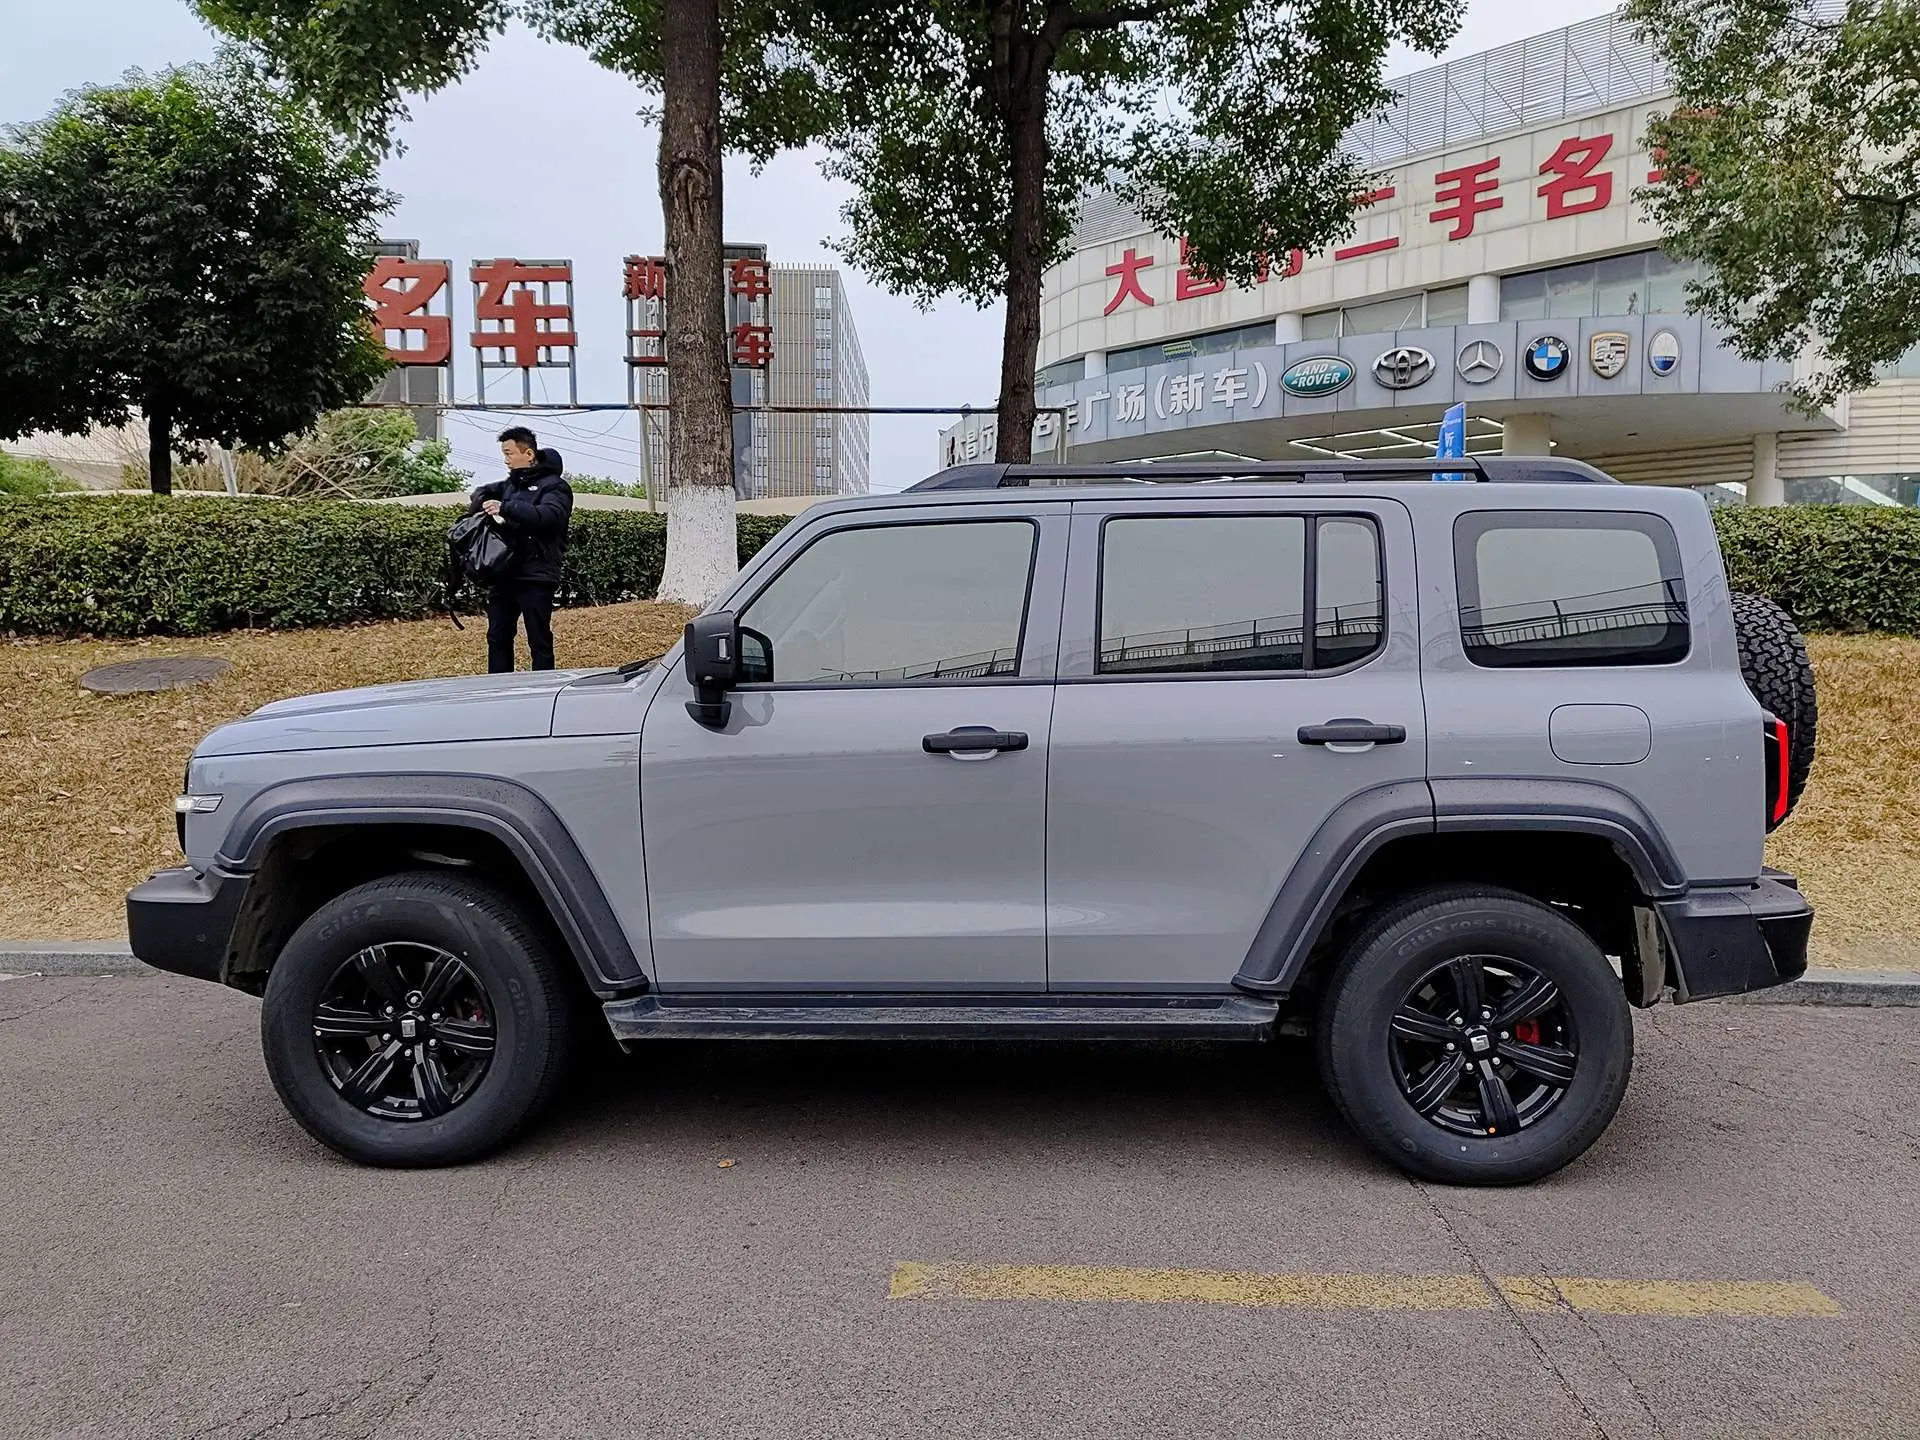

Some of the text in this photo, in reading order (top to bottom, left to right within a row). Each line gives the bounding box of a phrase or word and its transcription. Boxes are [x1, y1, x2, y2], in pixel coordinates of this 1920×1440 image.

[1530, 337, 1568, 352] BMW
[1295, 363, 1328, 377] LAND
[1298, 372, 1341, 388] ROVER
